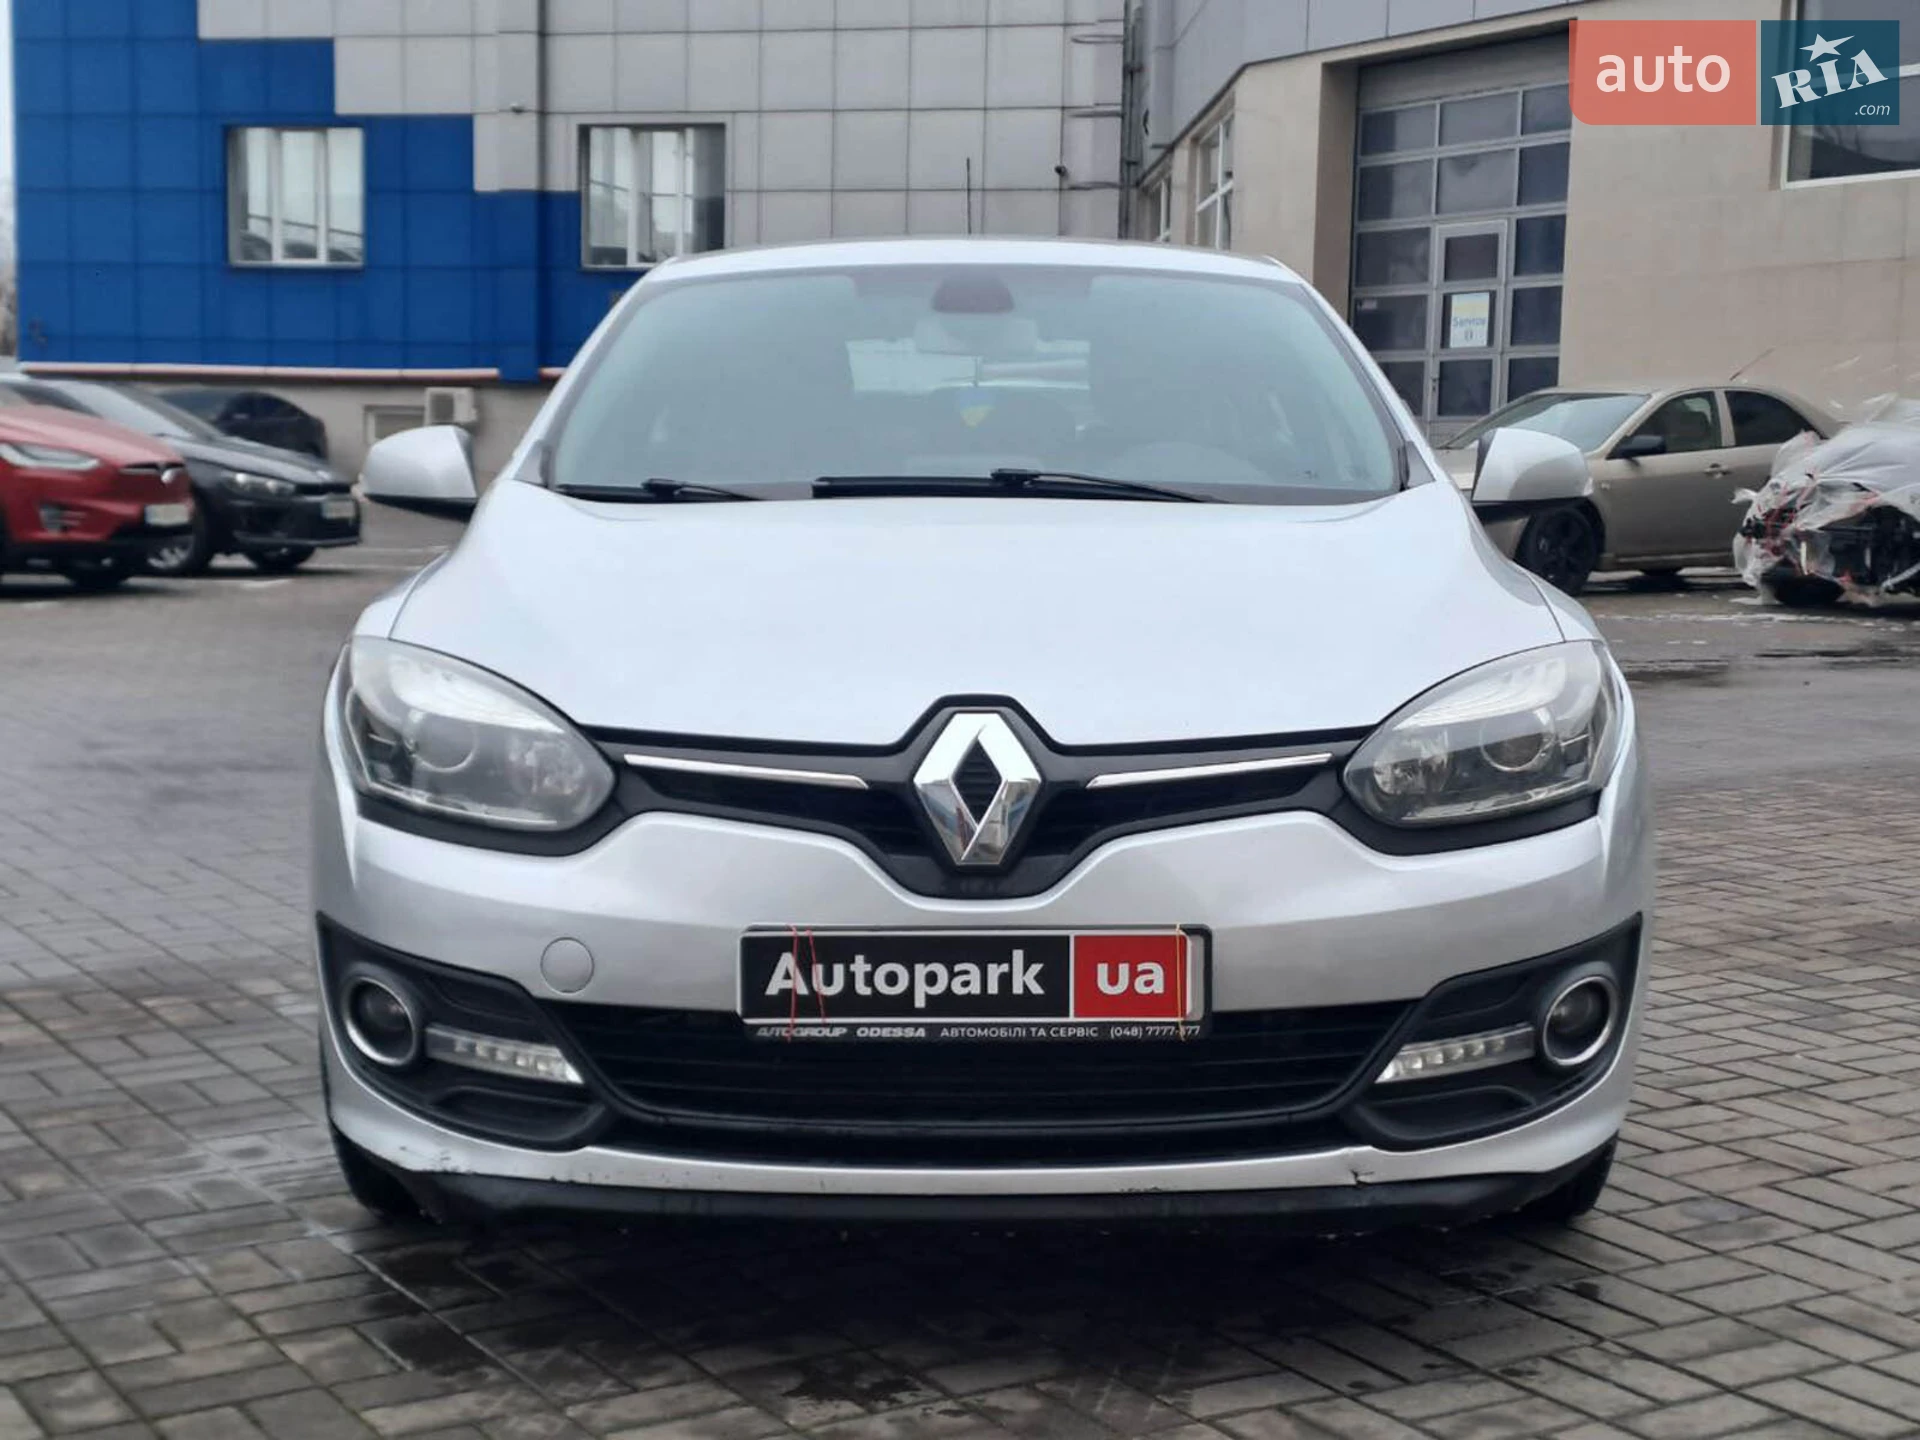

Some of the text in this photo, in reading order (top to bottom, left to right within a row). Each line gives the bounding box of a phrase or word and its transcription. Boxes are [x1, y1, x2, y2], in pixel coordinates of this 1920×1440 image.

[764, 948, 1165, 1009] Autopark ua
[856, 1026, 926, 1038] ODESSA
[940, 1026, 1099, 1038] АВТОМОБІЛІ ТА СЕРВІС
[1110, 1025, 1143, 1039] (048)
